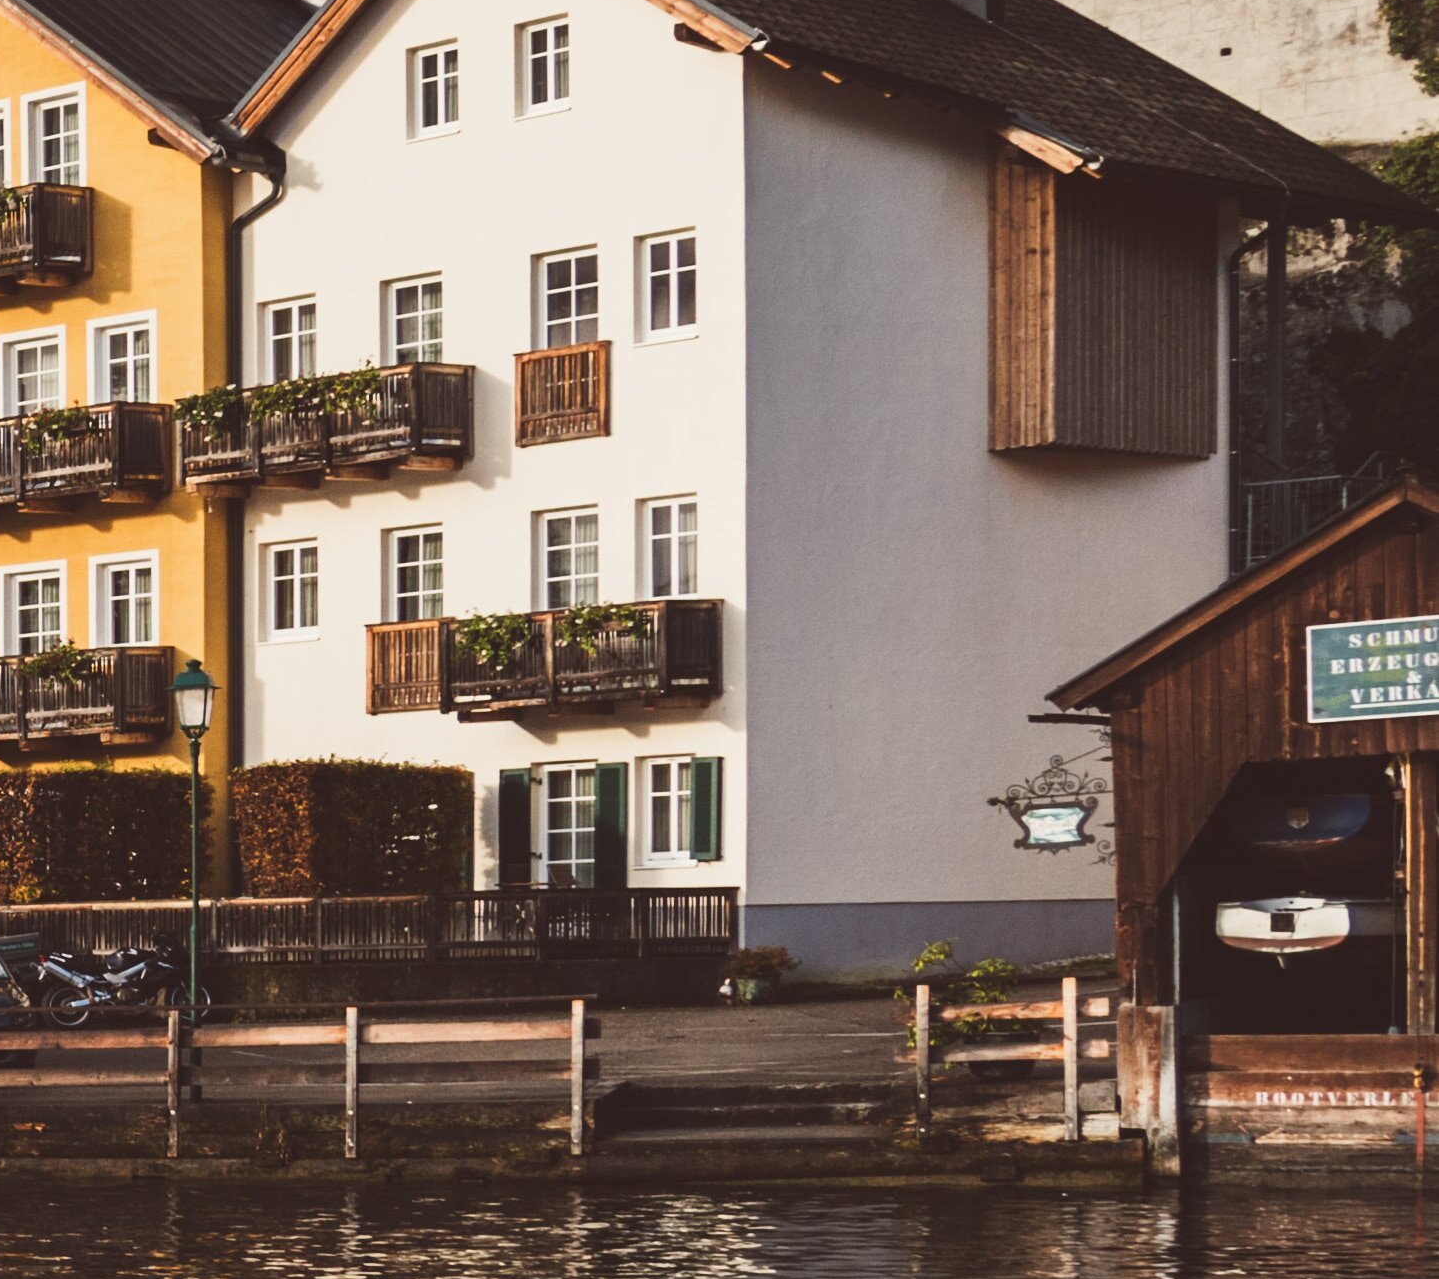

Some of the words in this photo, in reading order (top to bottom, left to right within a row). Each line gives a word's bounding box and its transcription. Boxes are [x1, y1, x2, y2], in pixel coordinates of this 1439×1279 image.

[1348, 628, 1439, 649] SCHMU
[1406, 669, 1423, 684] &
[1350, 680, 1439, 704] VERKA
